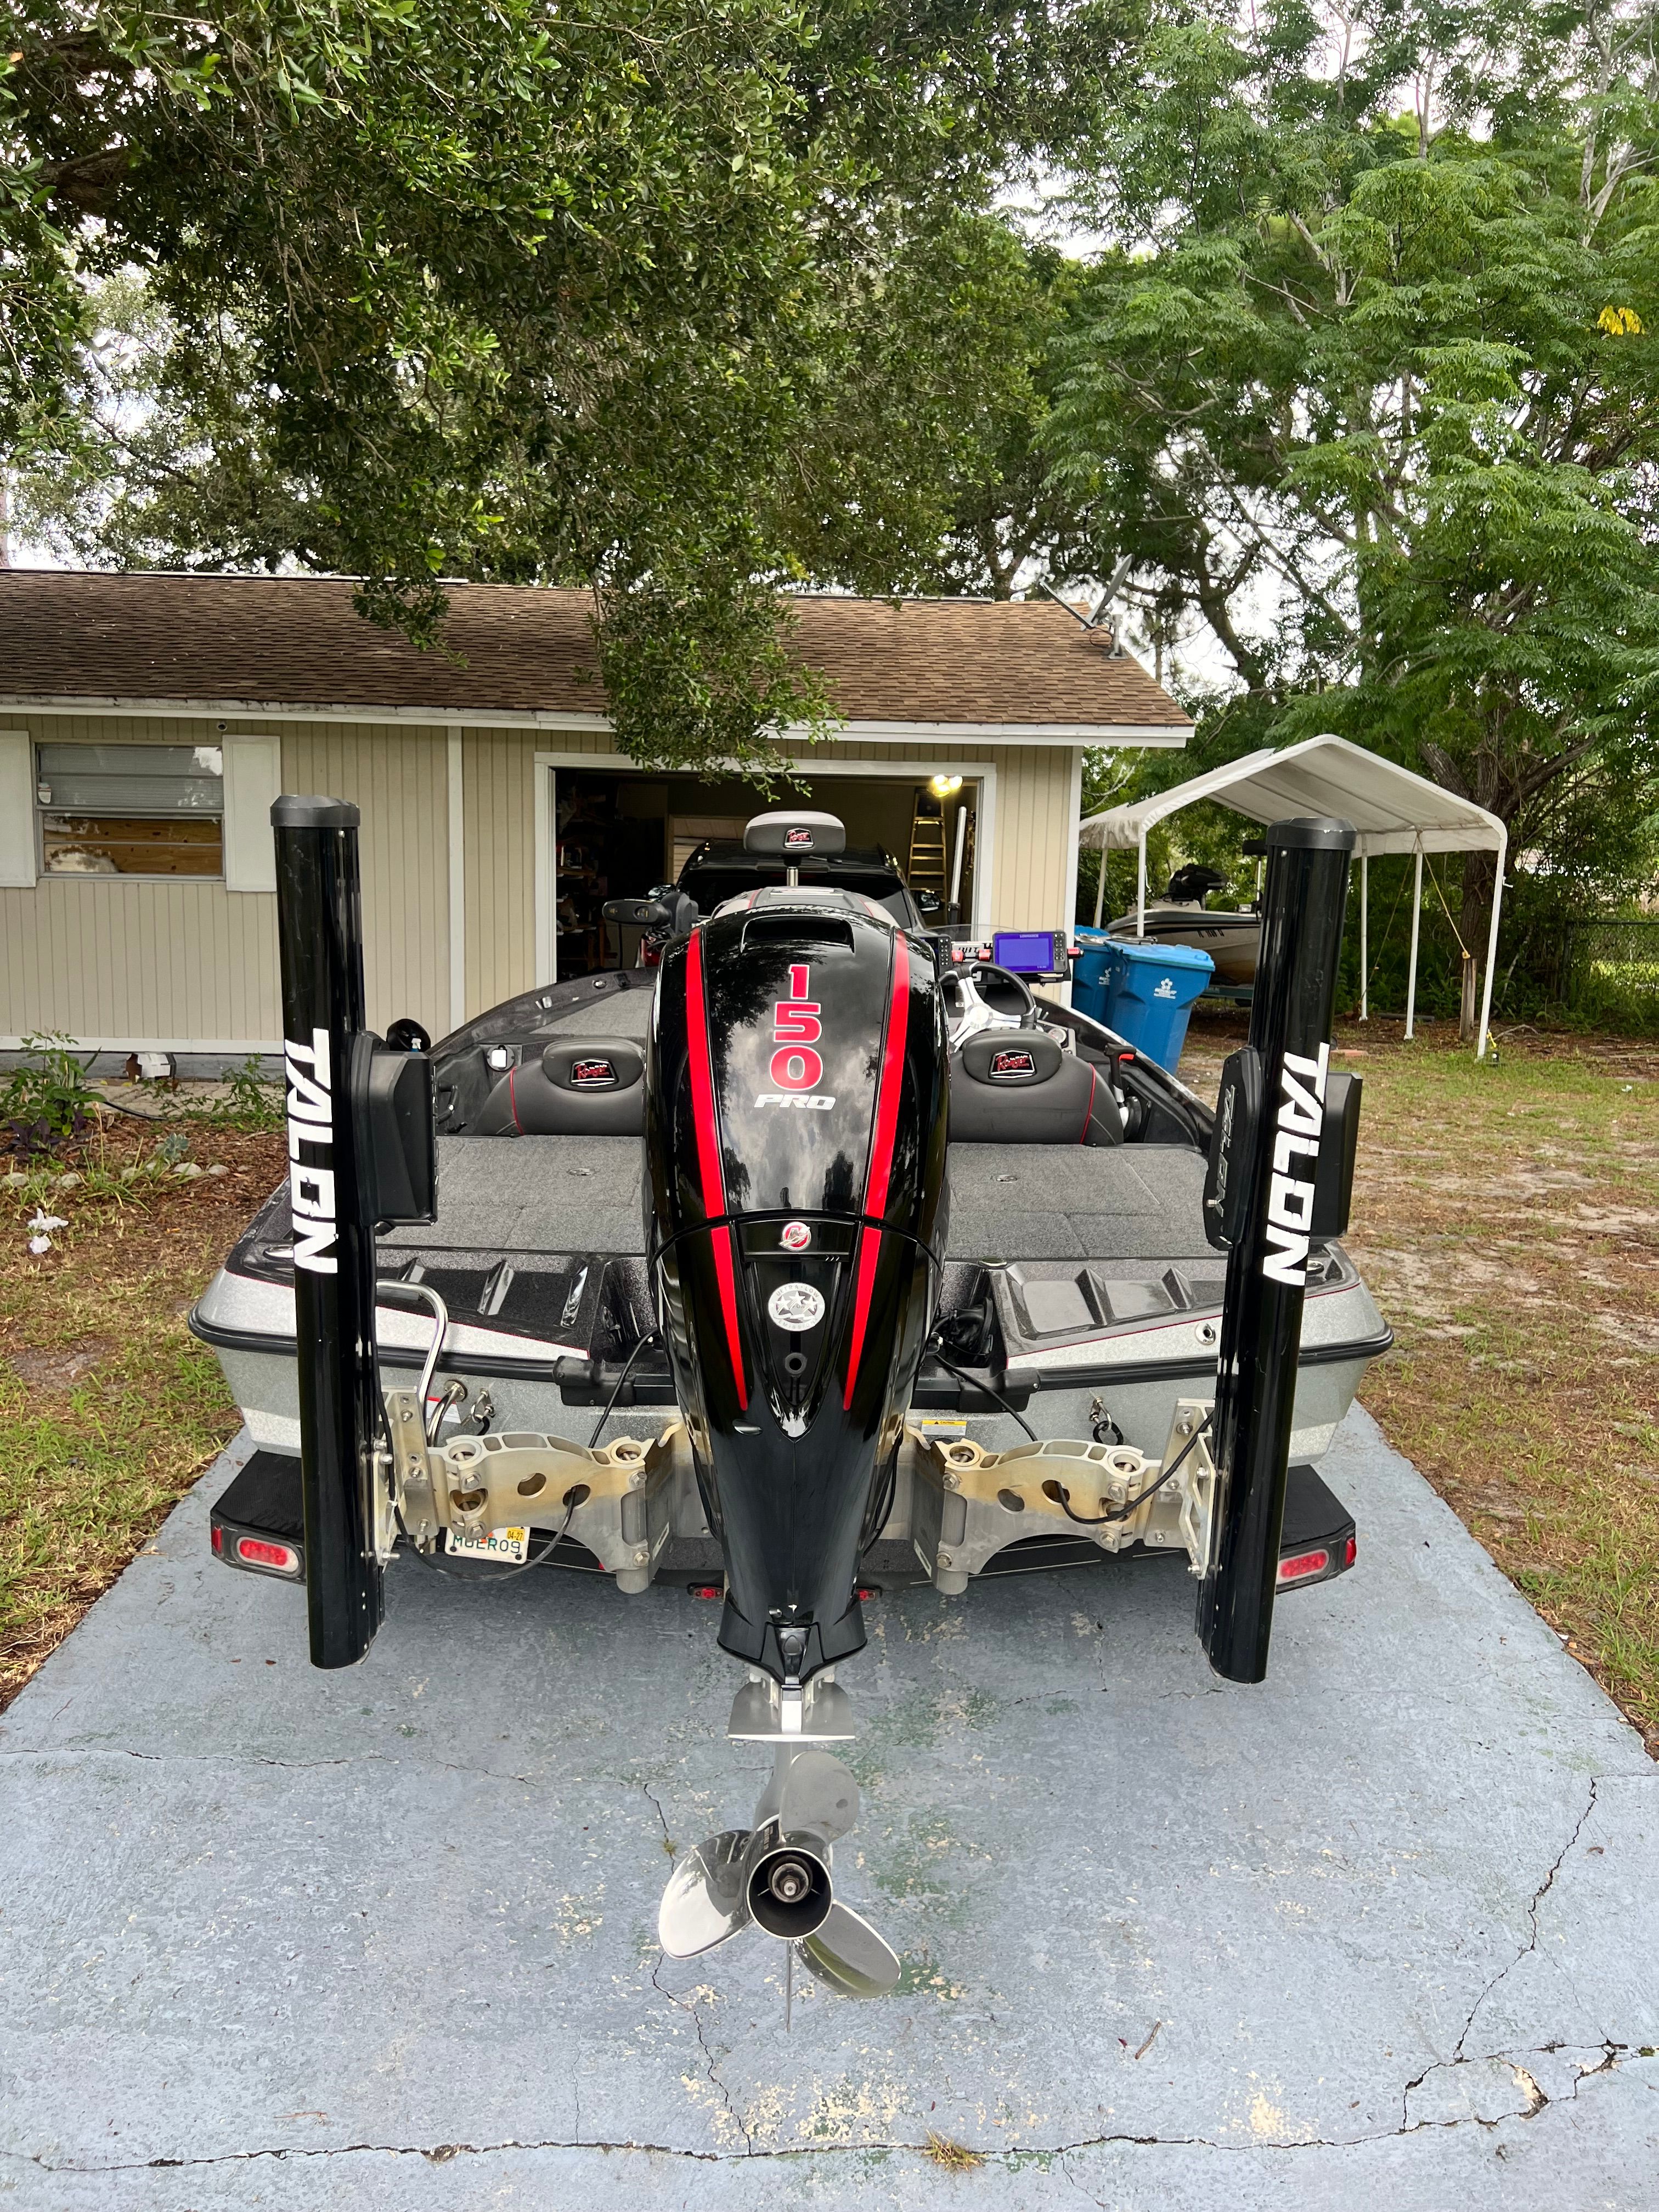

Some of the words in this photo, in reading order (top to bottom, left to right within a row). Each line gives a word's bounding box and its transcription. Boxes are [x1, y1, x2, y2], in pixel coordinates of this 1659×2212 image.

[770, 964, 823, 1091] 150
[284, 1028, 338, 1273] TALON
[754, 1094, 836, 1110] PRO
[1262, 1042, 1330, 1286] TALON
[804, 1286, 820, 1297] LOW
